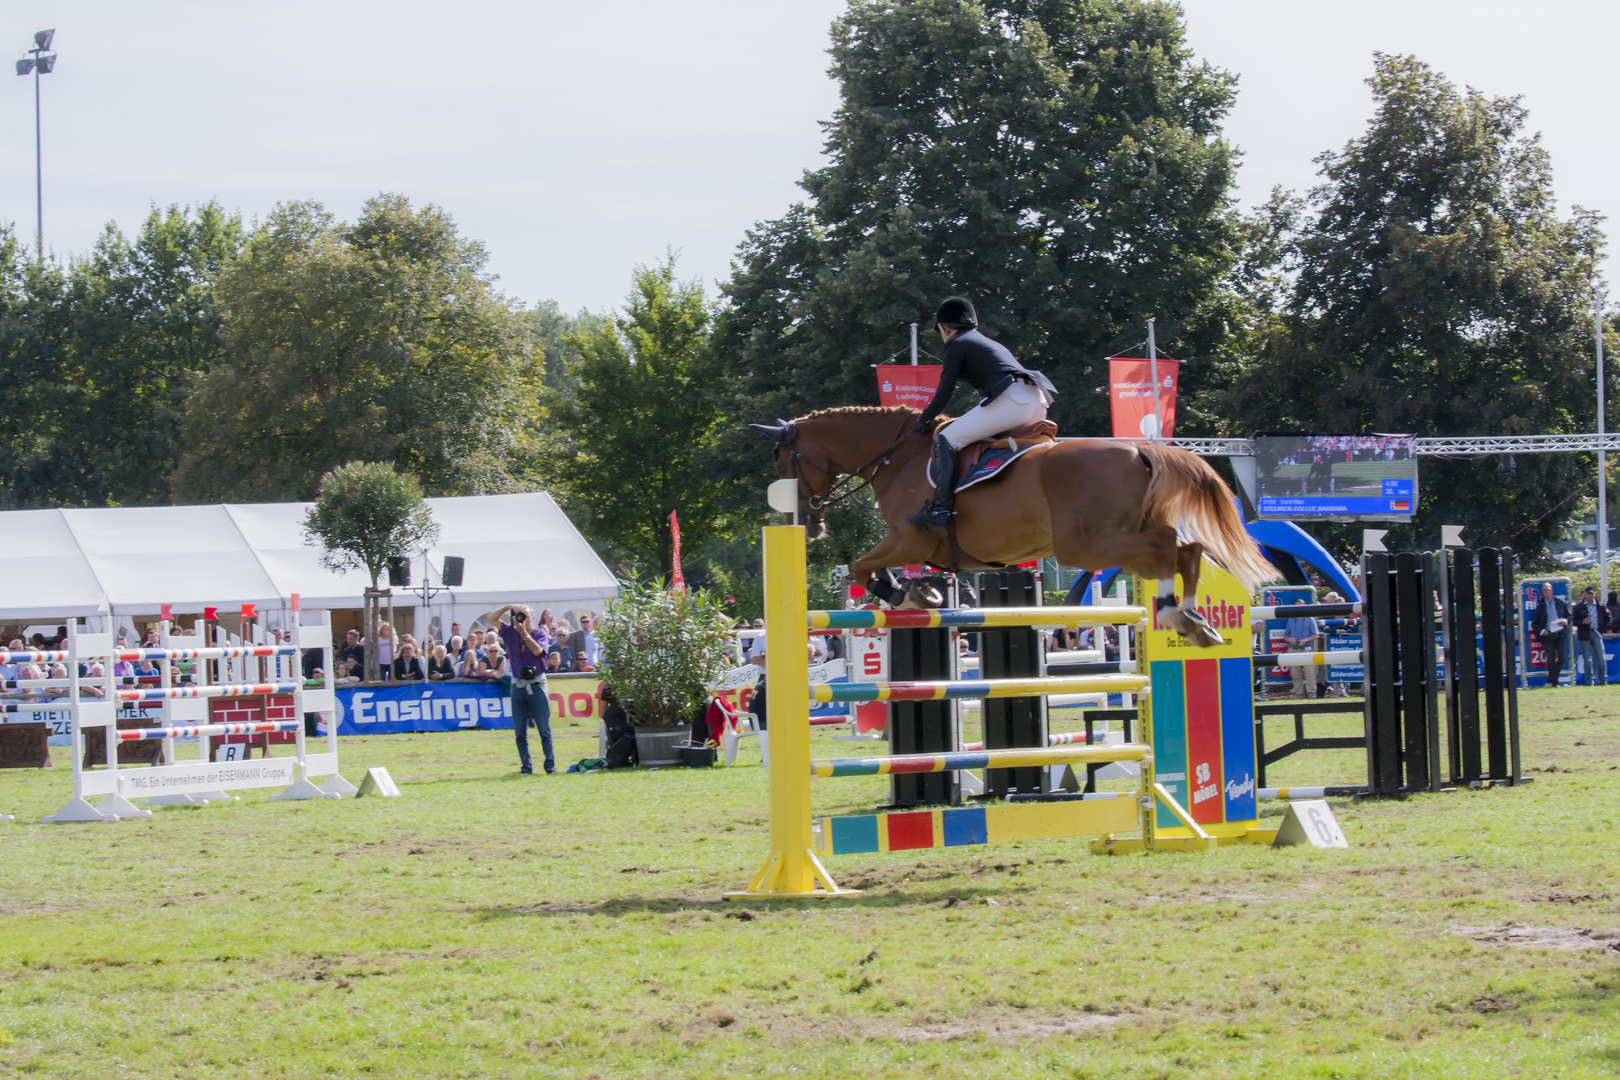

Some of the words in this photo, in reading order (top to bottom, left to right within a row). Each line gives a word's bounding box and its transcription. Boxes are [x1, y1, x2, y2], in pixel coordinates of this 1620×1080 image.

[150, 776, 160, 788] Ein
[161, 774, 206, 787] Unternehmen
[207, 772, 218, 784] der
[219, 768, 262, 783] EISENMANN
[1195, 762, 1212, 786] SB
[1193, 783, 1219, 805] MÖBEL
[1308, 807, 1334, 845] 6
